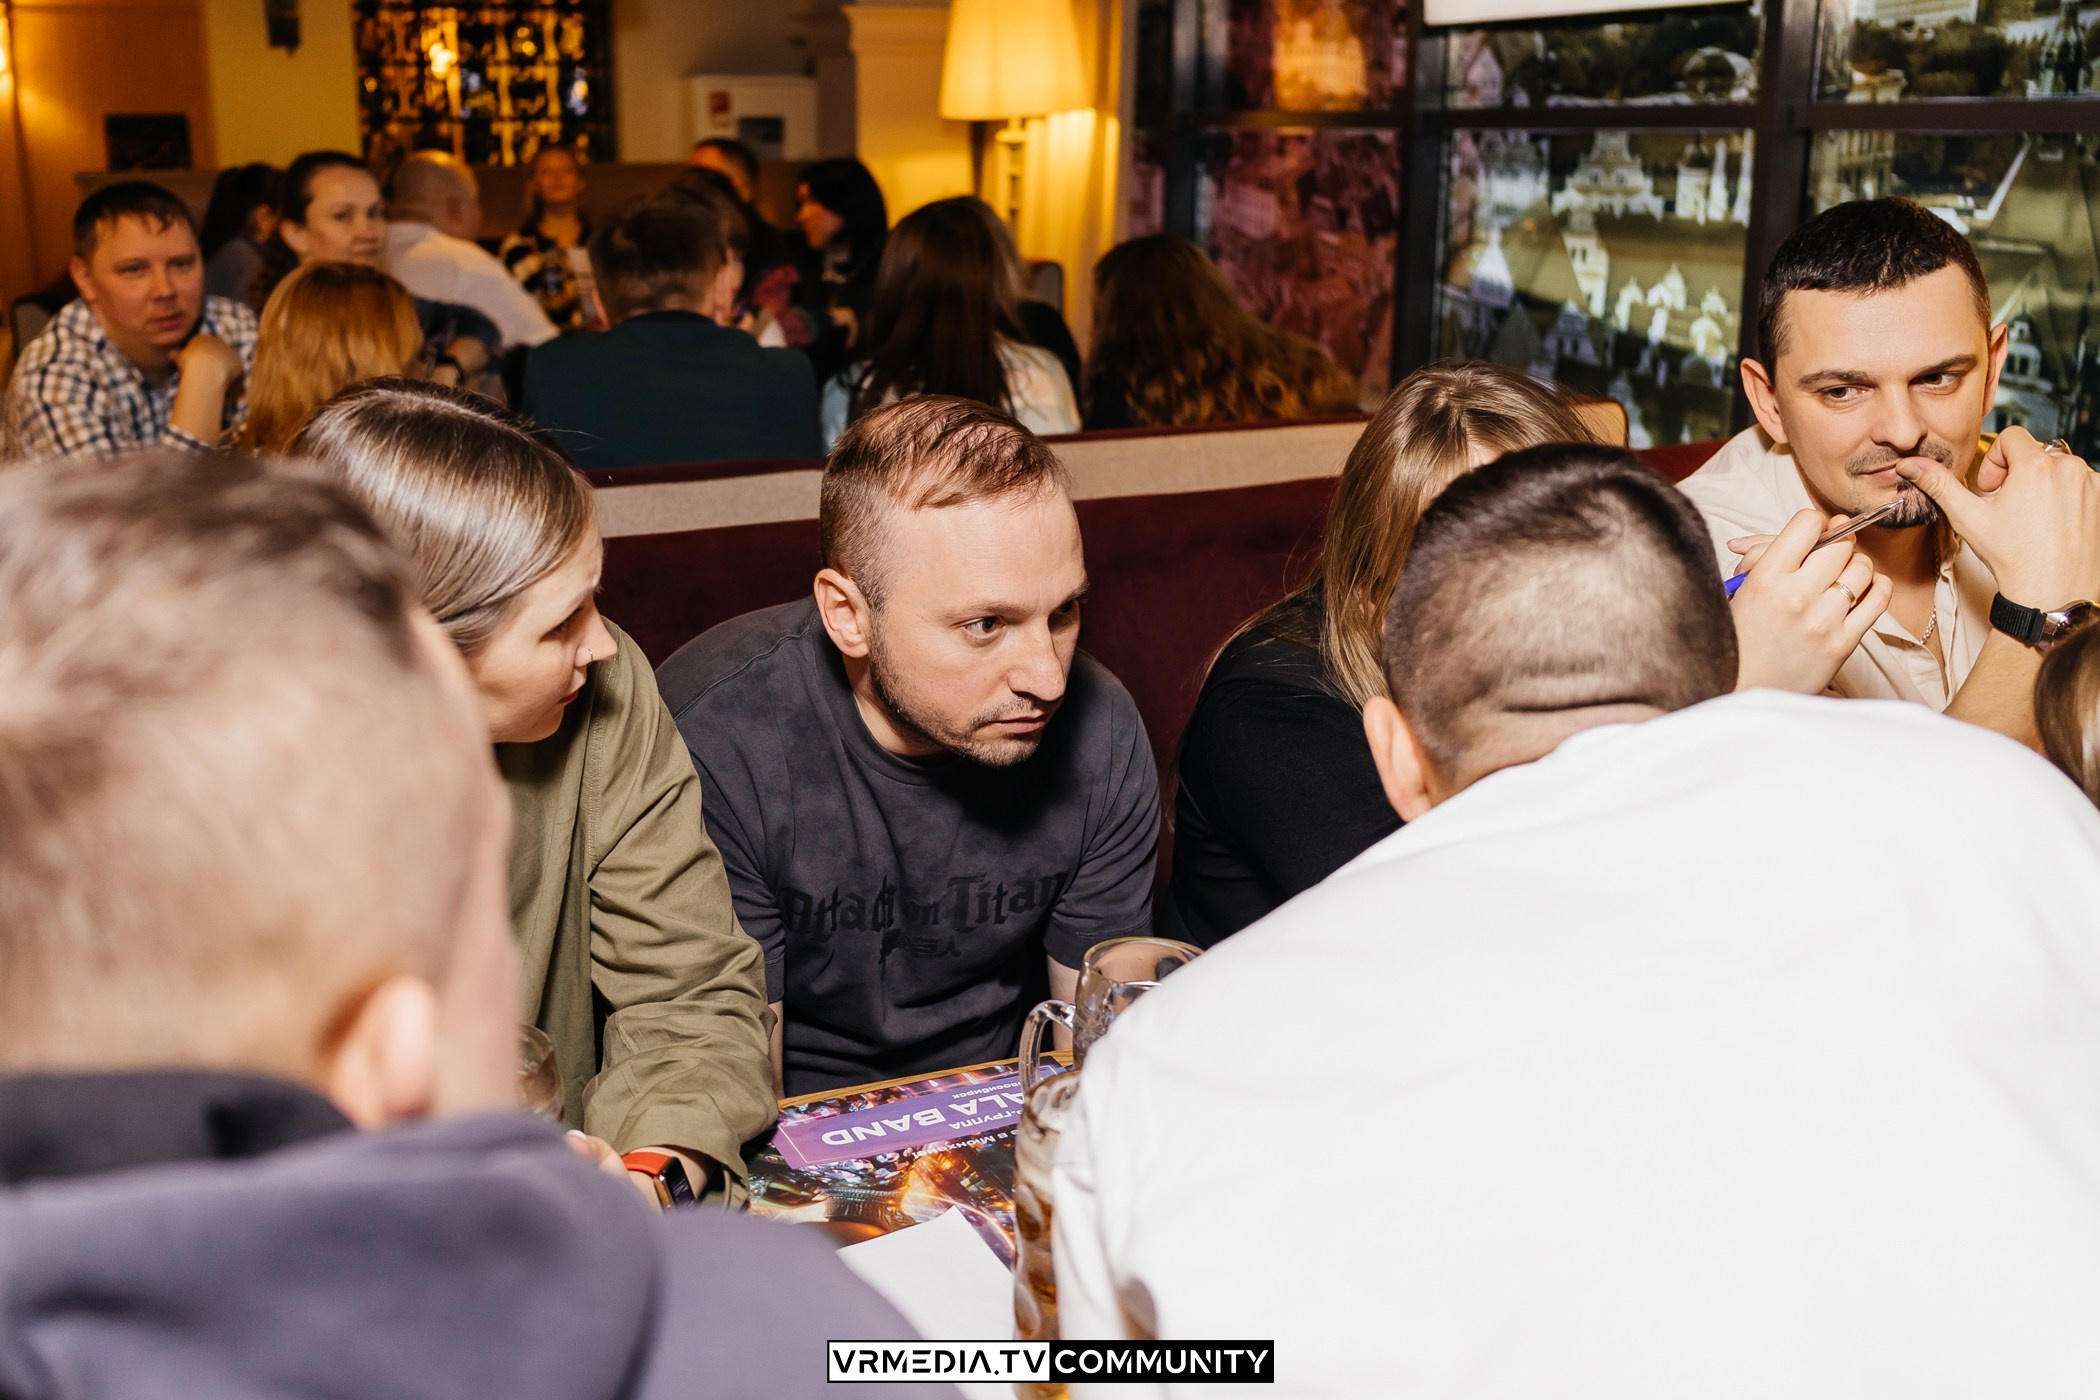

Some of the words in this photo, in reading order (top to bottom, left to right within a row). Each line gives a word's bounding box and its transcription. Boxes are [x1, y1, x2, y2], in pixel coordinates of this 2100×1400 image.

[903, 900, 940, 926] on
[948, 1092, 1024, 1116] ALA
[821, 1107, 947, 1146] BAND
